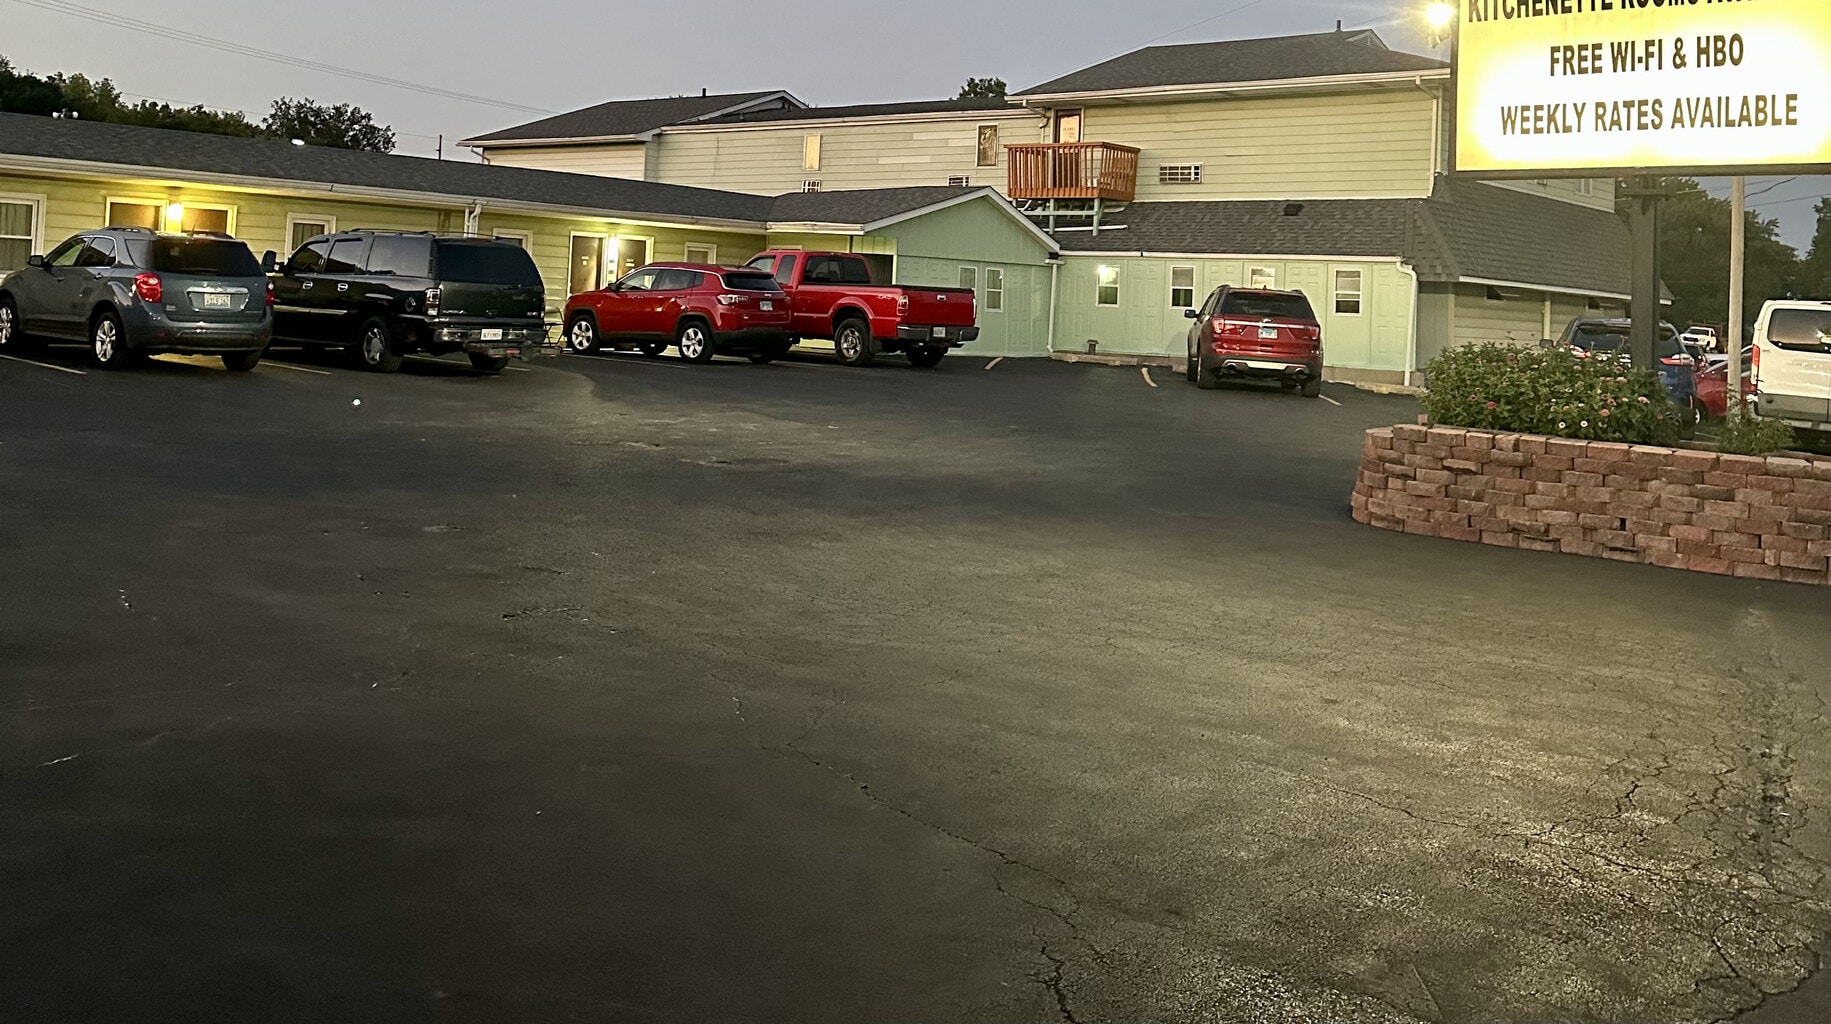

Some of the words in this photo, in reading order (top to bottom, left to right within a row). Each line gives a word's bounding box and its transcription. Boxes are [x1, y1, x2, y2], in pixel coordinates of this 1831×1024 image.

[1550, 42, 1603, 77] FREE
[1611, 38, 1664, 73] WI-FI
[1672, 37, 1687, 69] &
[1697, 33, 1744, 68] HBO
[1501, 102, 1587, 136] WEEKLY
[1594, 98, 1664, 132] RATES
[1671, 93, 1798, 130] AVAILABLE
